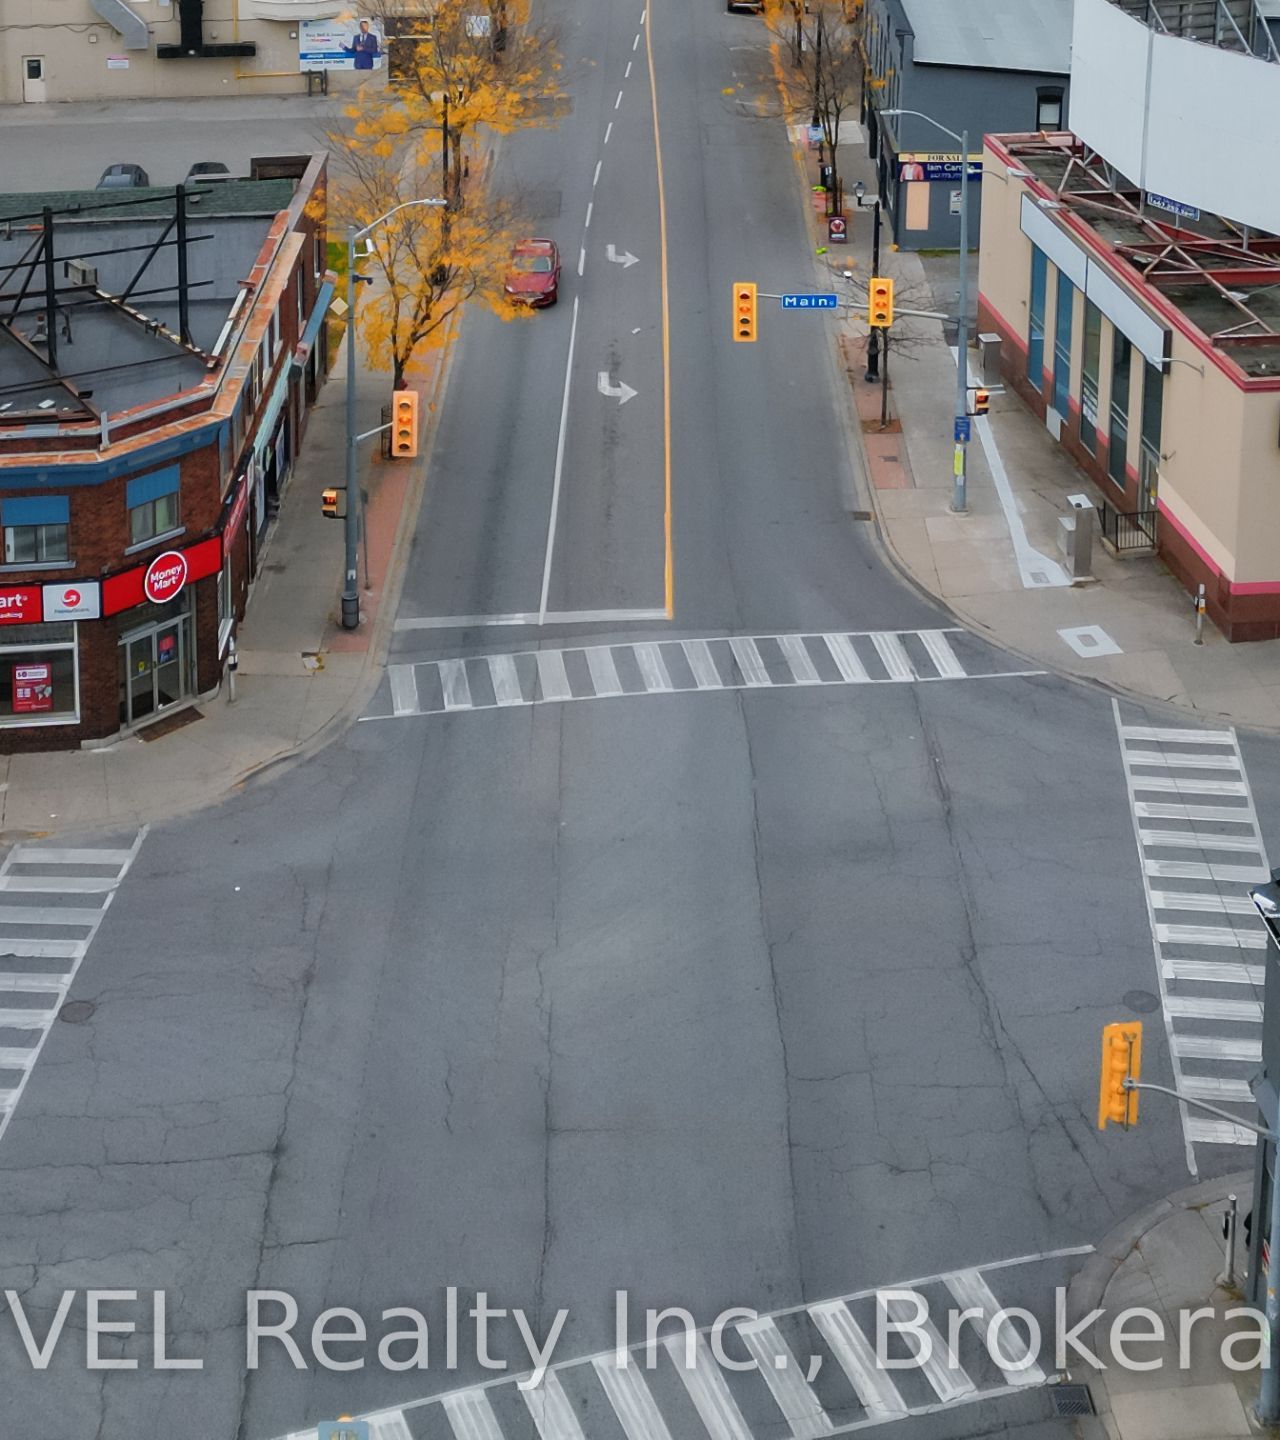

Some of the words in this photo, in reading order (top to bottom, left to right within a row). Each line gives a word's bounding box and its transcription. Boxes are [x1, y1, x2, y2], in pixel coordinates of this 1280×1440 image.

[785, 297, 828, 306] Main
[151, 564, 182, 583] Money
[154, 576, 176, 592] Mart
